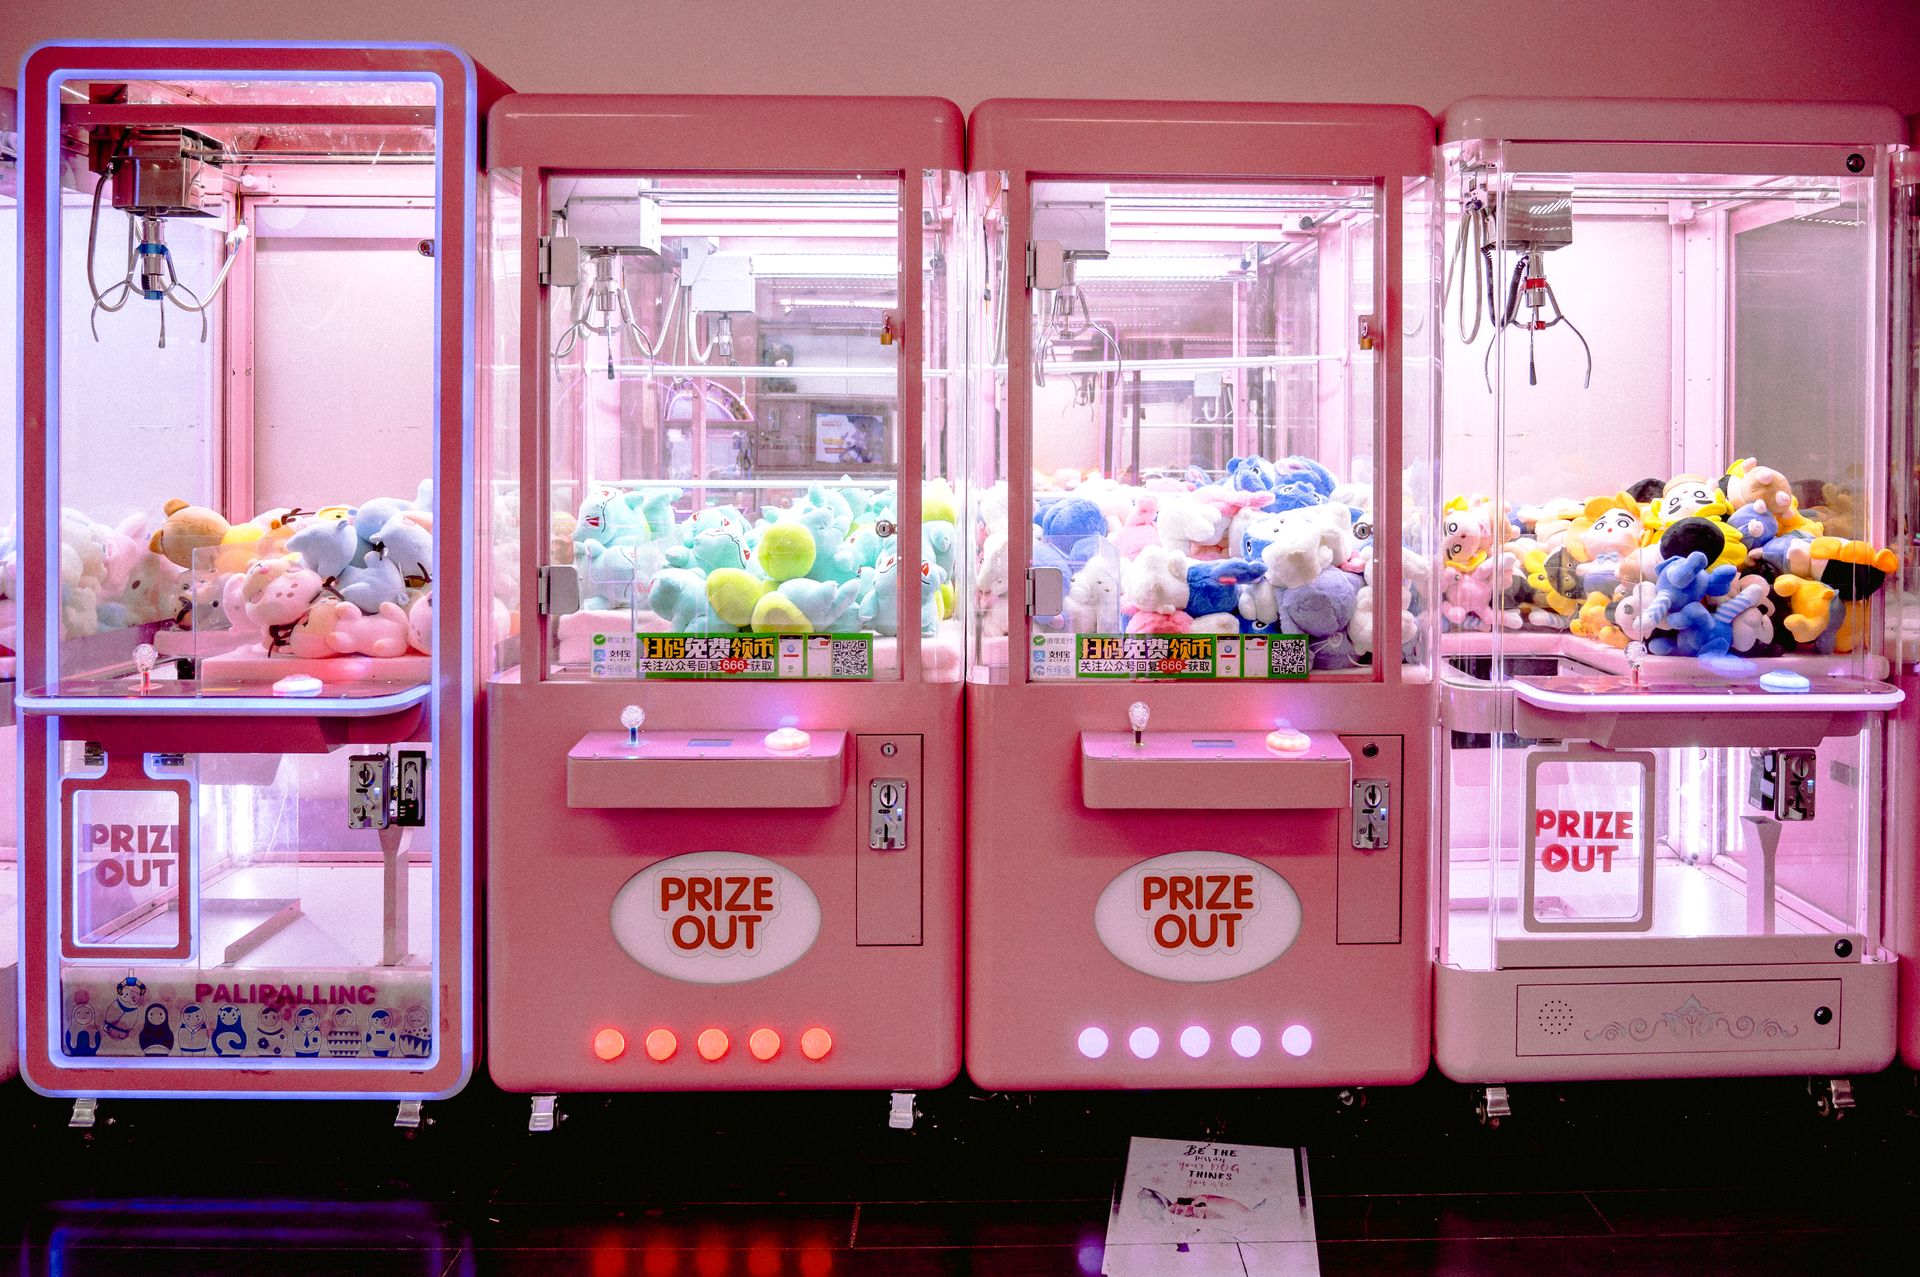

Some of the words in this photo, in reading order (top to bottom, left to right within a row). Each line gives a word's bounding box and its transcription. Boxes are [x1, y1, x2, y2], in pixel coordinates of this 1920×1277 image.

[609, 649, 632, 658] 支付宝
[642, 637, 775, 659] 扫码免费领币
[1048, 650, 1071, 659] 支付宝
[1080, 638, 1213, 660] 扫码免费领币
[1535, 808, 1633, 839] PRIZE
[95, 858, 175, 888] OUT
[1541, 843, 1619, 873] OUT
[661, 876, 774, 912] PRIZE
[1143, 874, 1254, 911] PRIZE
[672, 914, 763, 950] OUT
[1154, 912, 1243, 949] OUT
[1183, 1143, 1211, 1156] BE
[1213, 1148, 1238, 1157] THE
